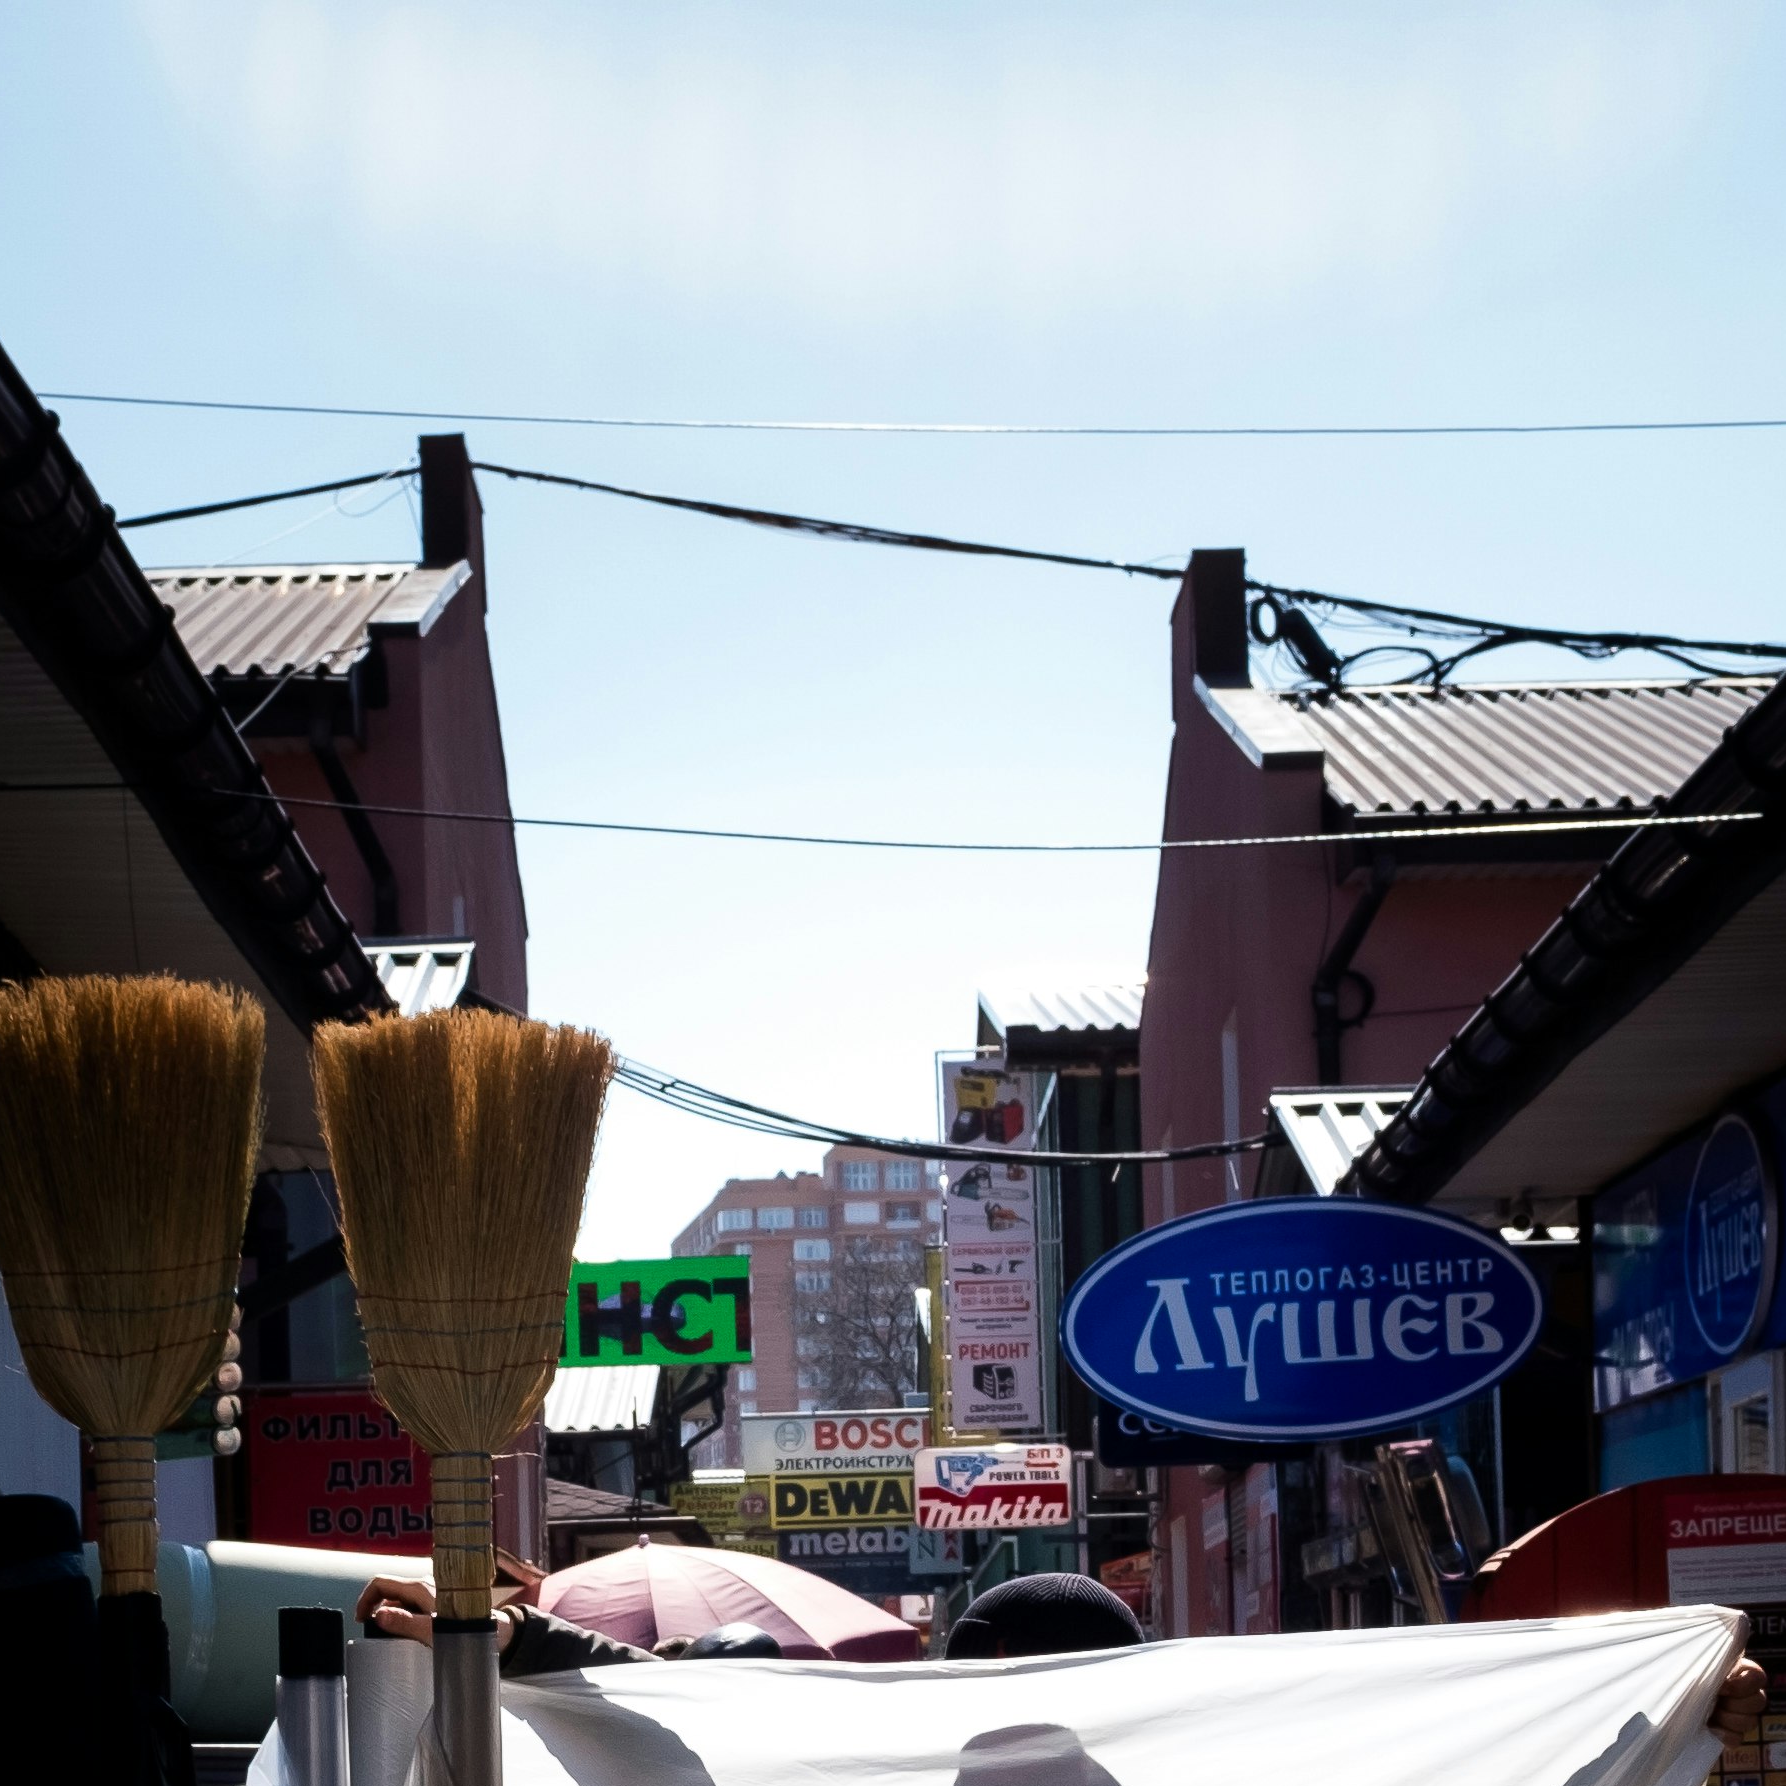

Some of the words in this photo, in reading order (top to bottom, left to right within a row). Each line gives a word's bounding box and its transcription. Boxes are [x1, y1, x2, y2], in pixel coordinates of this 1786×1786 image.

[1210, 1258, 1494, 1297] ТЕПЛОГАЗ-ЦЕНТР
[559, 1277, 750, 1357] НСТ
[958, 1343, 1030, 1361] РЕМОНТ
[263, 1409, 401, 1441] ФИЛЬТ
[325, 1458, 413, 1495] ДЛЯ
[989, 1470, 1026, 1481] POWER
[308, 1504, 433, 1538] ВОДЫ
